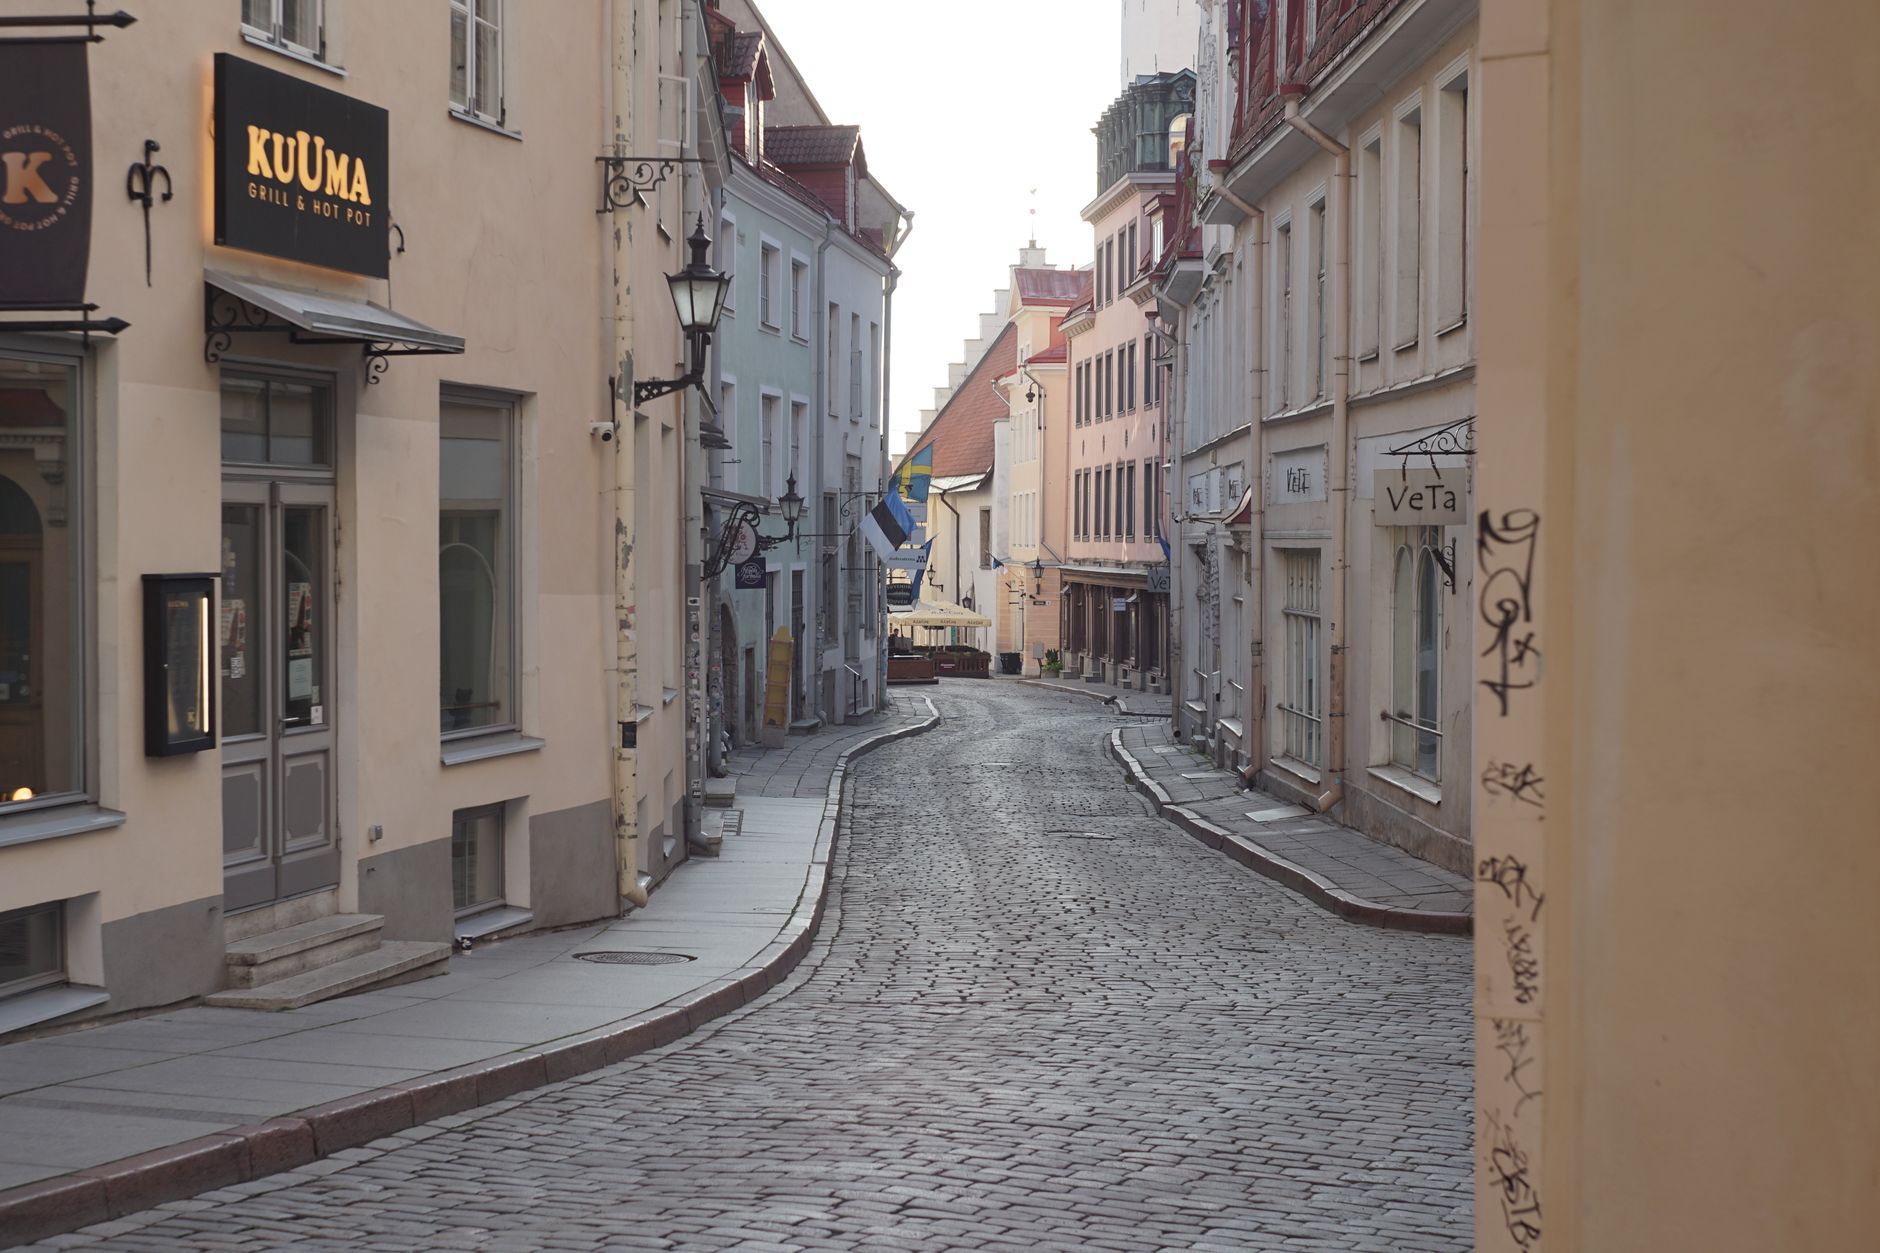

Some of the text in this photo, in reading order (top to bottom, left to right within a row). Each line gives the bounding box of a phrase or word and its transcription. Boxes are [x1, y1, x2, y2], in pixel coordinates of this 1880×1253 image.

[2, 151, 59, 204] K
[247, 125, 371, 206] KUUMA
[248, 182, 371, 227] GRILL & HOT POT
[1386, 484, 1457, 512] VeTa
